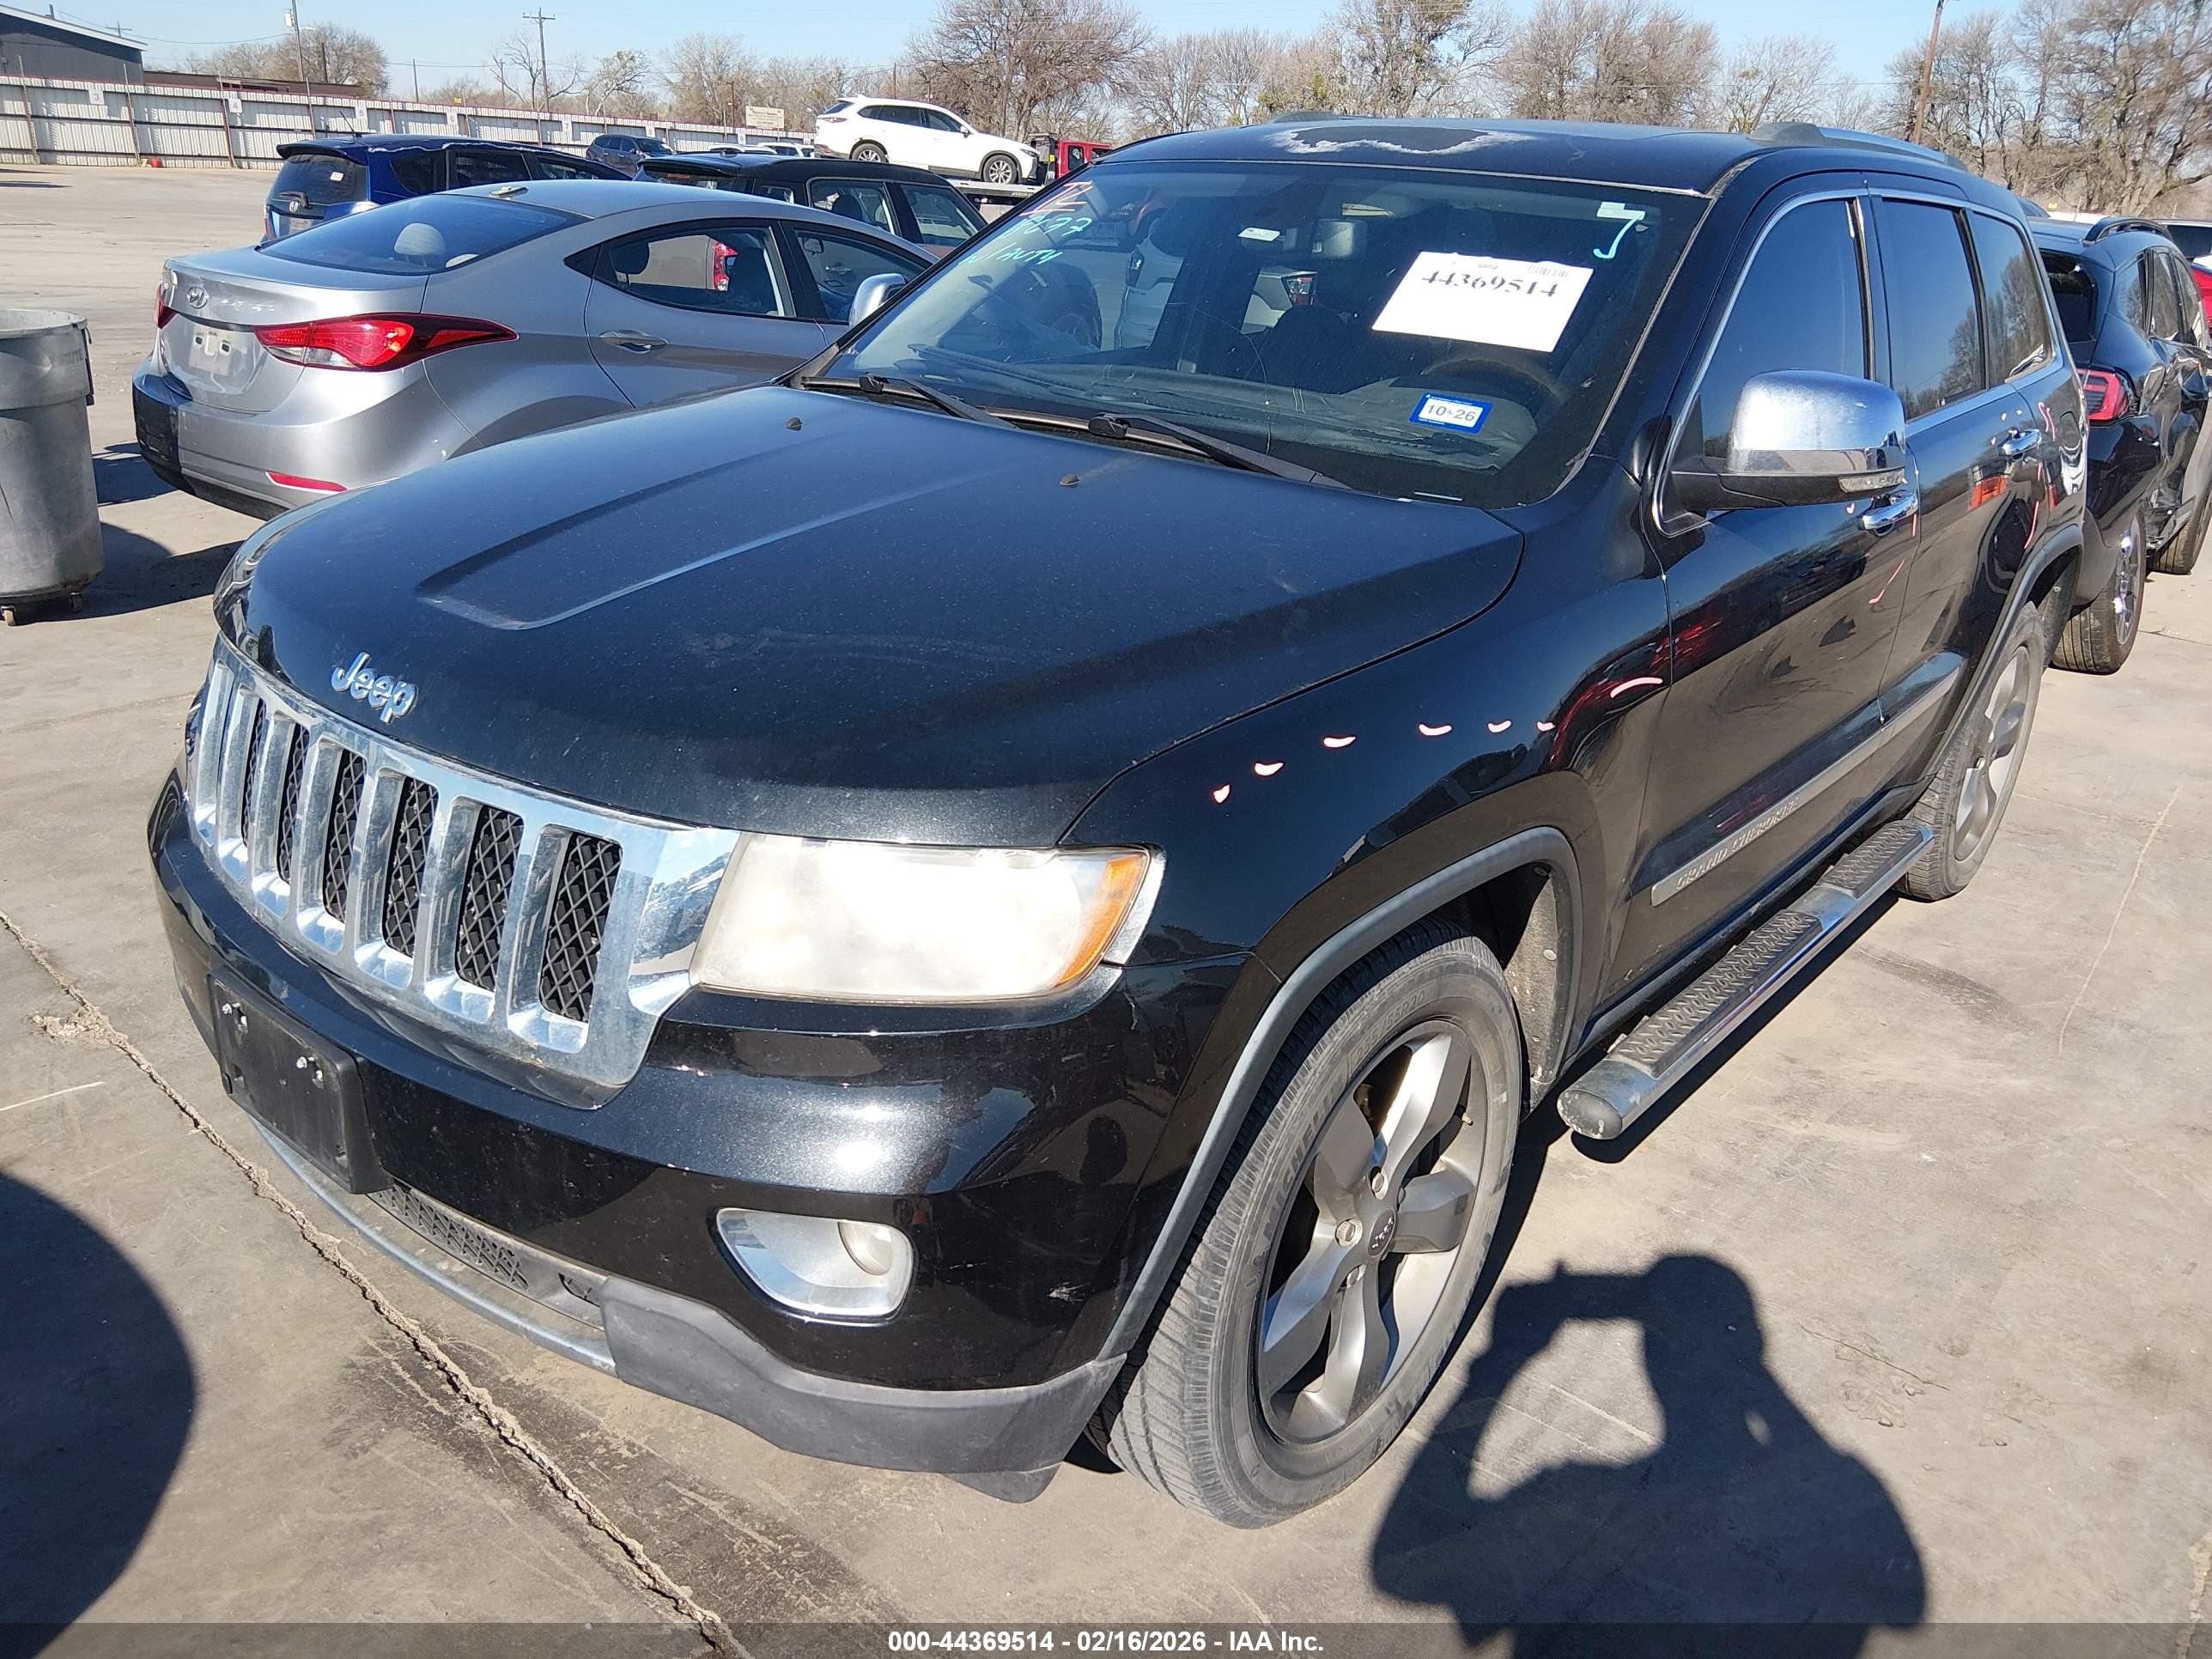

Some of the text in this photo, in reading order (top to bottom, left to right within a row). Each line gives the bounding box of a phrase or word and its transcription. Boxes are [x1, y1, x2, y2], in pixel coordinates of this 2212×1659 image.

[1422, 270, 1559, 297] 44369514
[331, 652, 419, 725] Jeep
[1676, 848, 1729, 890] GRAND
